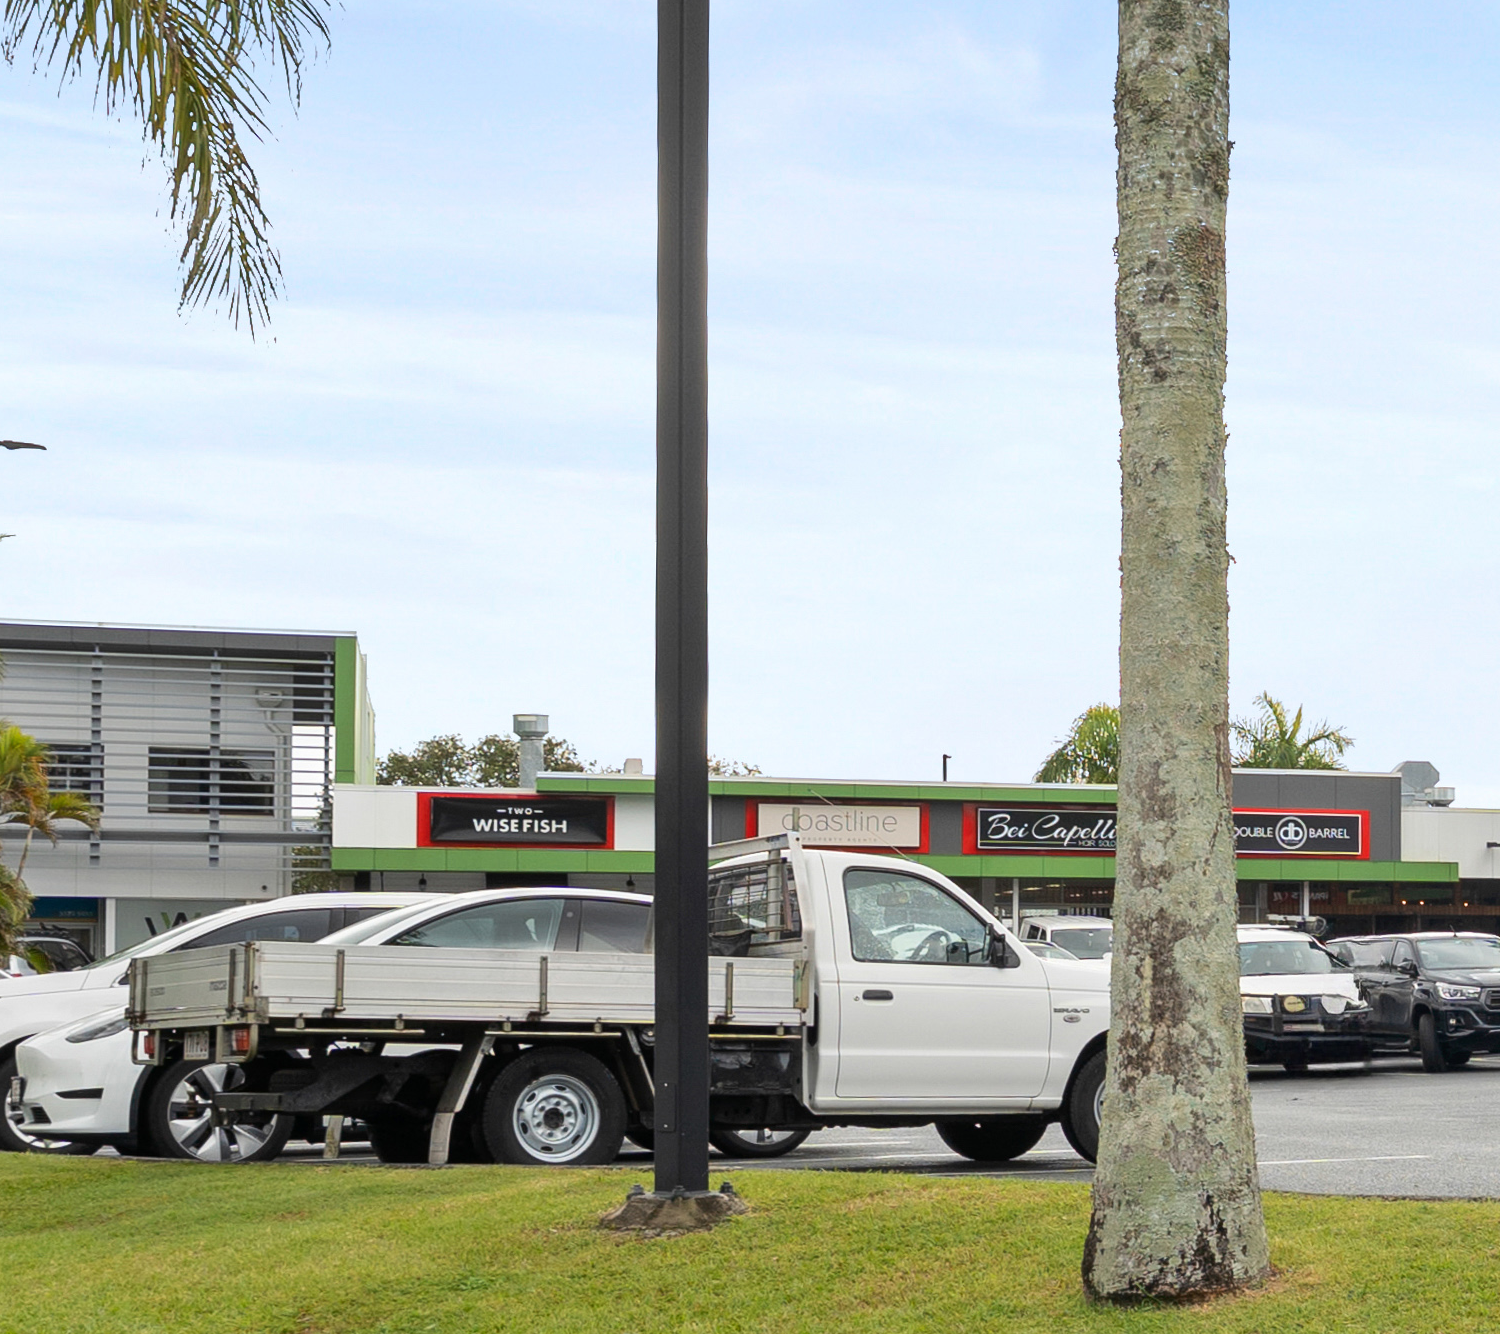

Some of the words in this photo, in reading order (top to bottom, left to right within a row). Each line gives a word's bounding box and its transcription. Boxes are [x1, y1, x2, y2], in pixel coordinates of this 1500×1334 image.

[508, 807, 533, 815] TWO
[473, 819, 519, 832] WISE
[523, 819, 567, 833] FISH
[988, 813, 1029, 839] Bei
[1032, 814, 1117, 847] Capelli
[1309, 828, 1350, 839] BARREL
